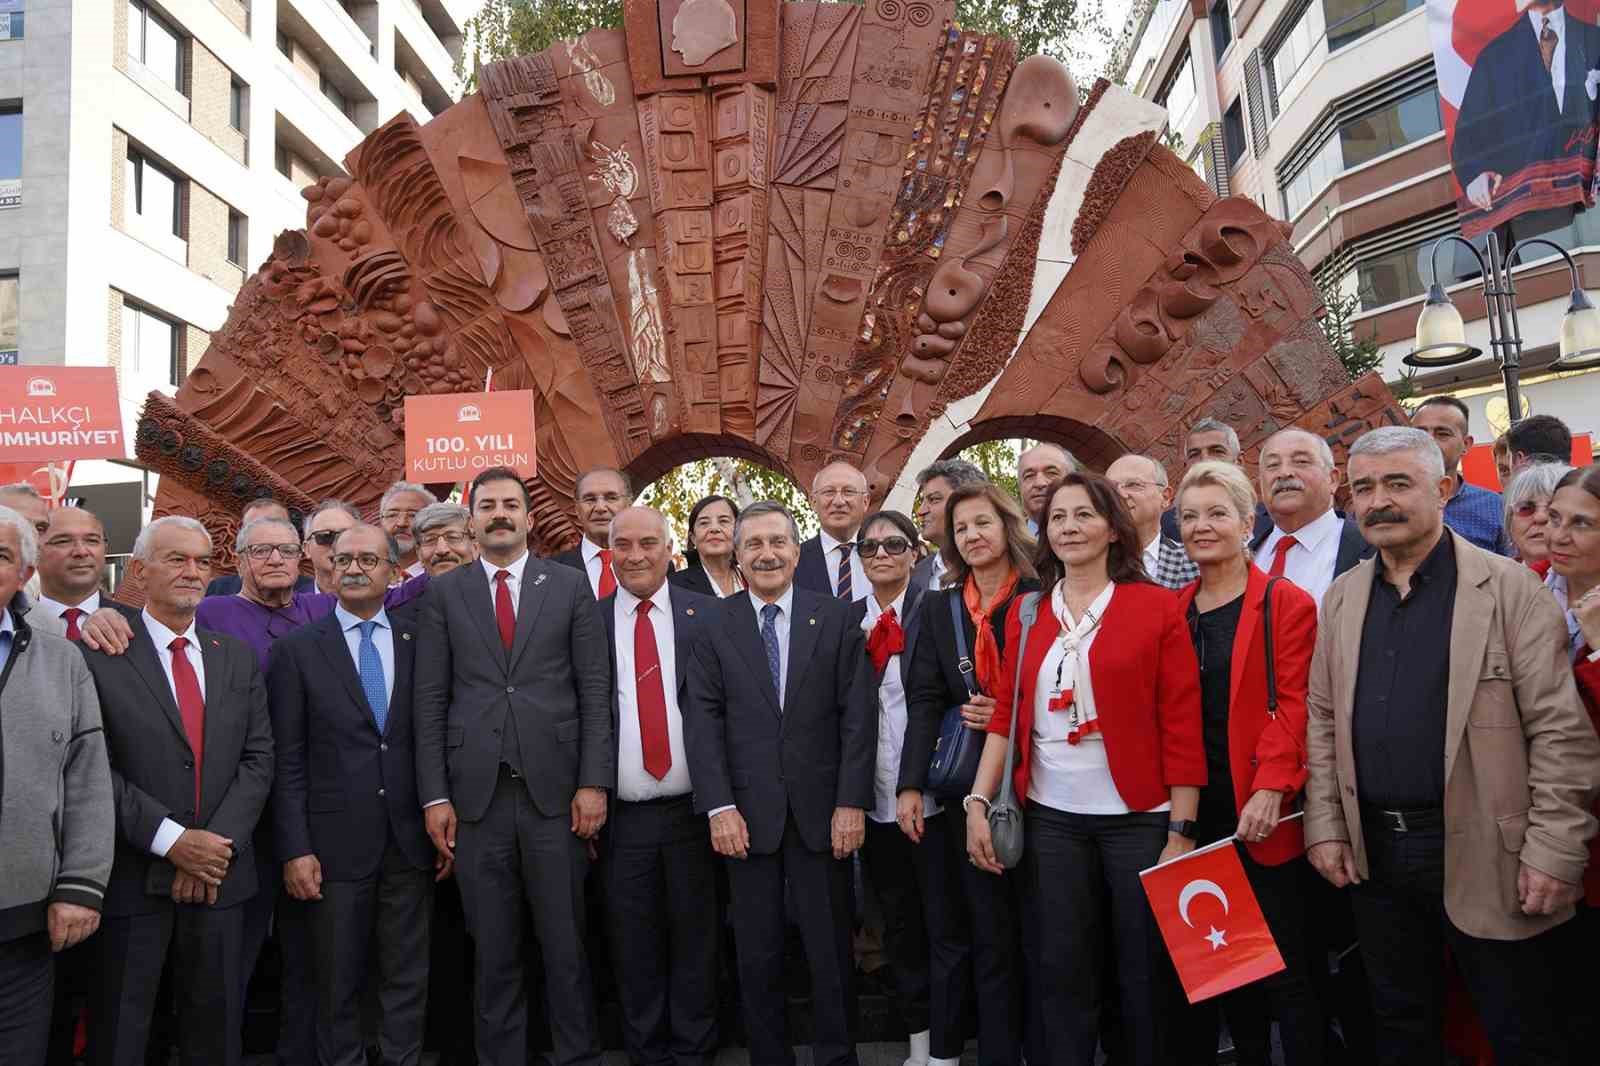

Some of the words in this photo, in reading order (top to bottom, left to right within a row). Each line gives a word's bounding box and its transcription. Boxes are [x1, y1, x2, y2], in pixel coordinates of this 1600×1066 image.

[0, 406, 91, 430] HALKÇI
[425, 436, 470, 454] 100.
[474, 433, 513, 451] YILI
[413, 456, 467, 472] KUTLU
[471, 452, 528, 469] OLSUN
